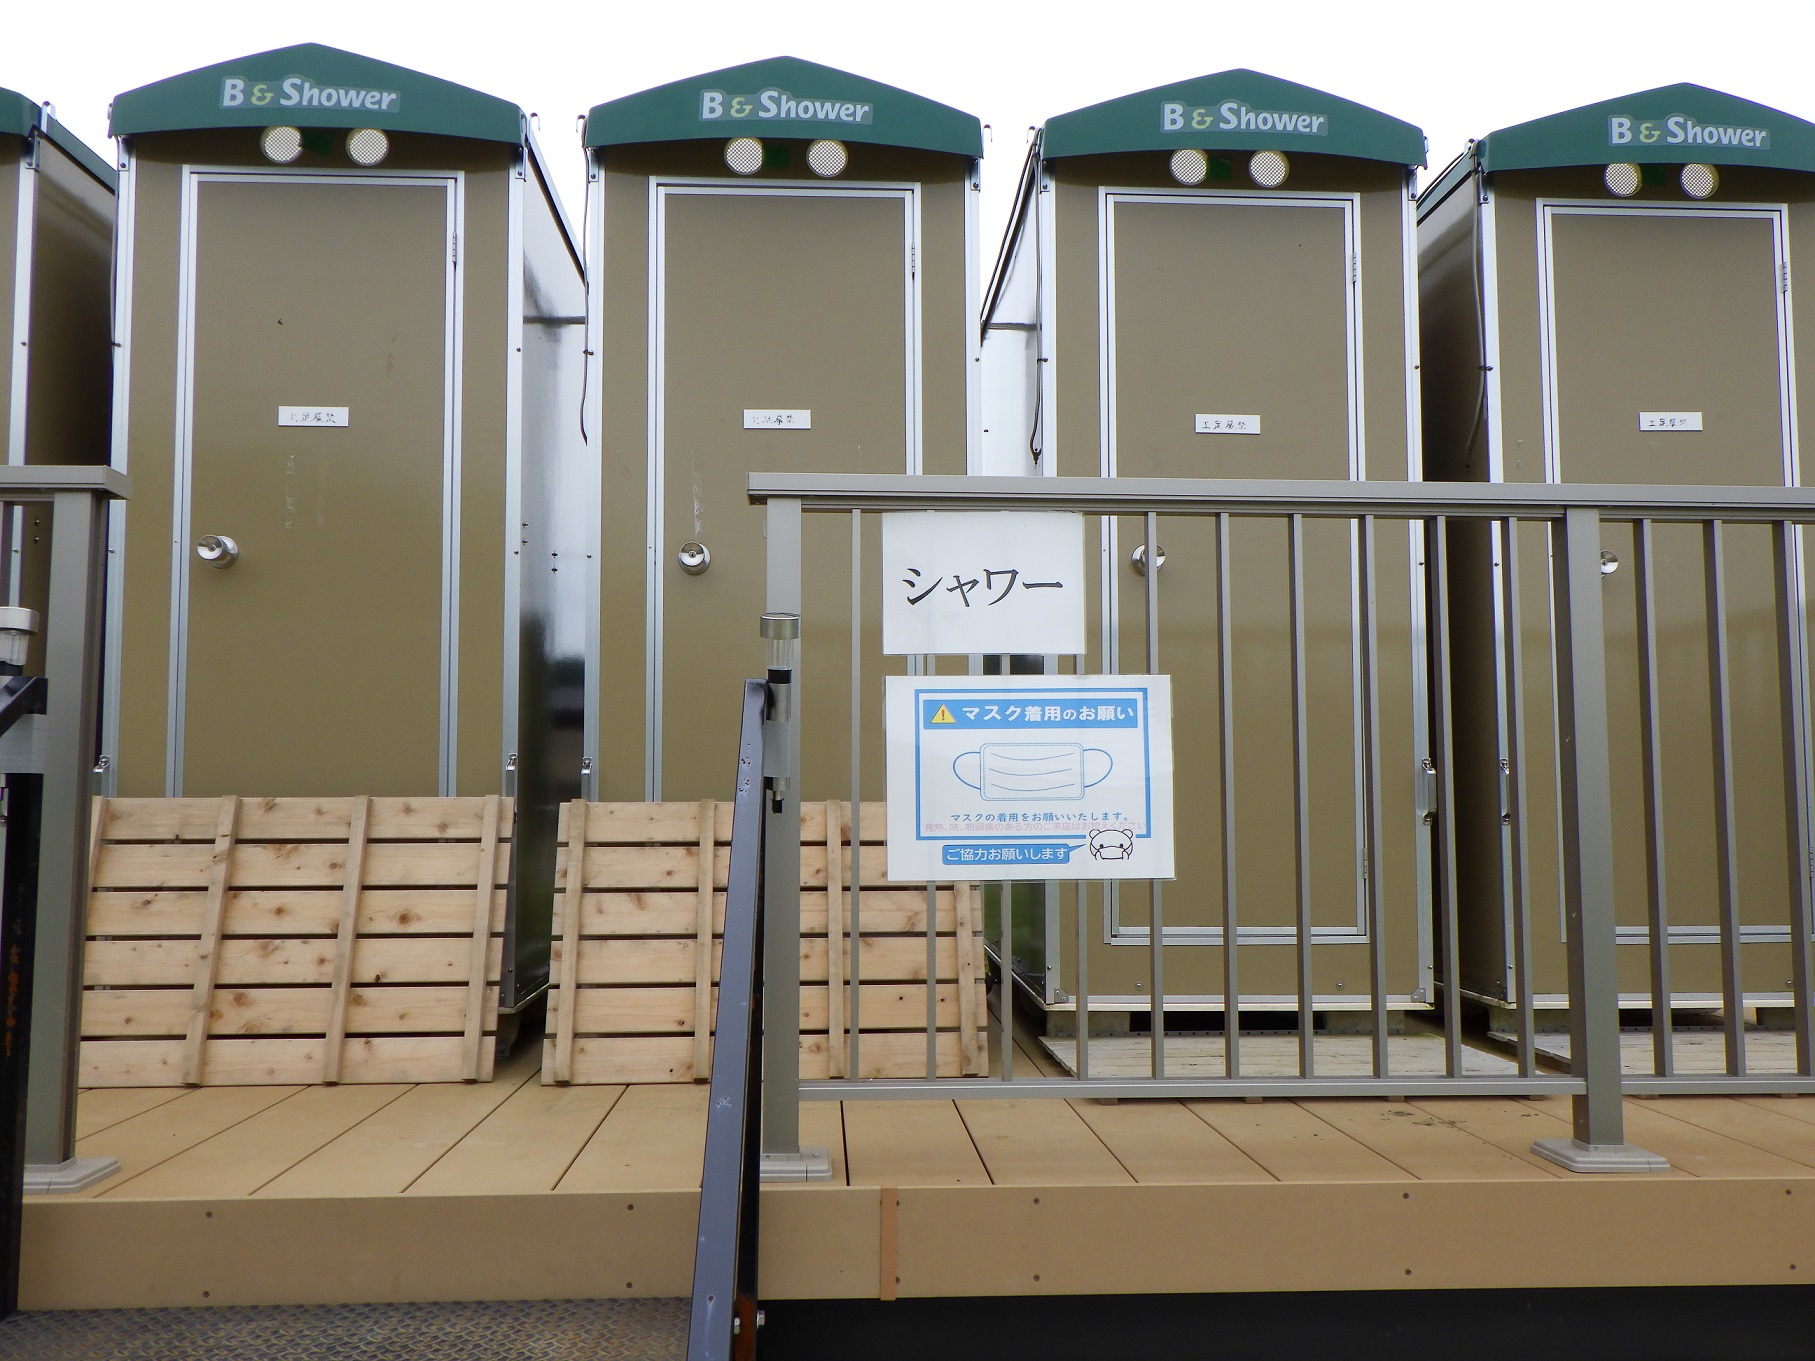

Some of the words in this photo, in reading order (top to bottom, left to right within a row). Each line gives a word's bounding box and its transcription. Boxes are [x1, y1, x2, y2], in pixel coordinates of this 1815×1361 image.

[223, 79, 244, 106] B
[251, 84, 274, 106] &
[279, 77, 397, 110] Shower
[702, 91, 723, 119] B
[730, 97, 753, 118] &
[758, 90, 869, 122] Shower
[1163, 103, 1184, 130] B
[1191, 109, 1214, 129] &
[1219, 102, 1325, 133] Shower
[1611, 118, 1632, 144] B
[1638, 123, 1661, 143] &
[1666, 117, 1767, 148] Shower
[902, 568, 1064, 607] シャワー
[962, 704, 1134, 722] マスク着用のお願い
[950, 811, 1129, 823] マスクの着用をお願いいたします。
[946, 847, 1068, 861] ご協力お願いします
